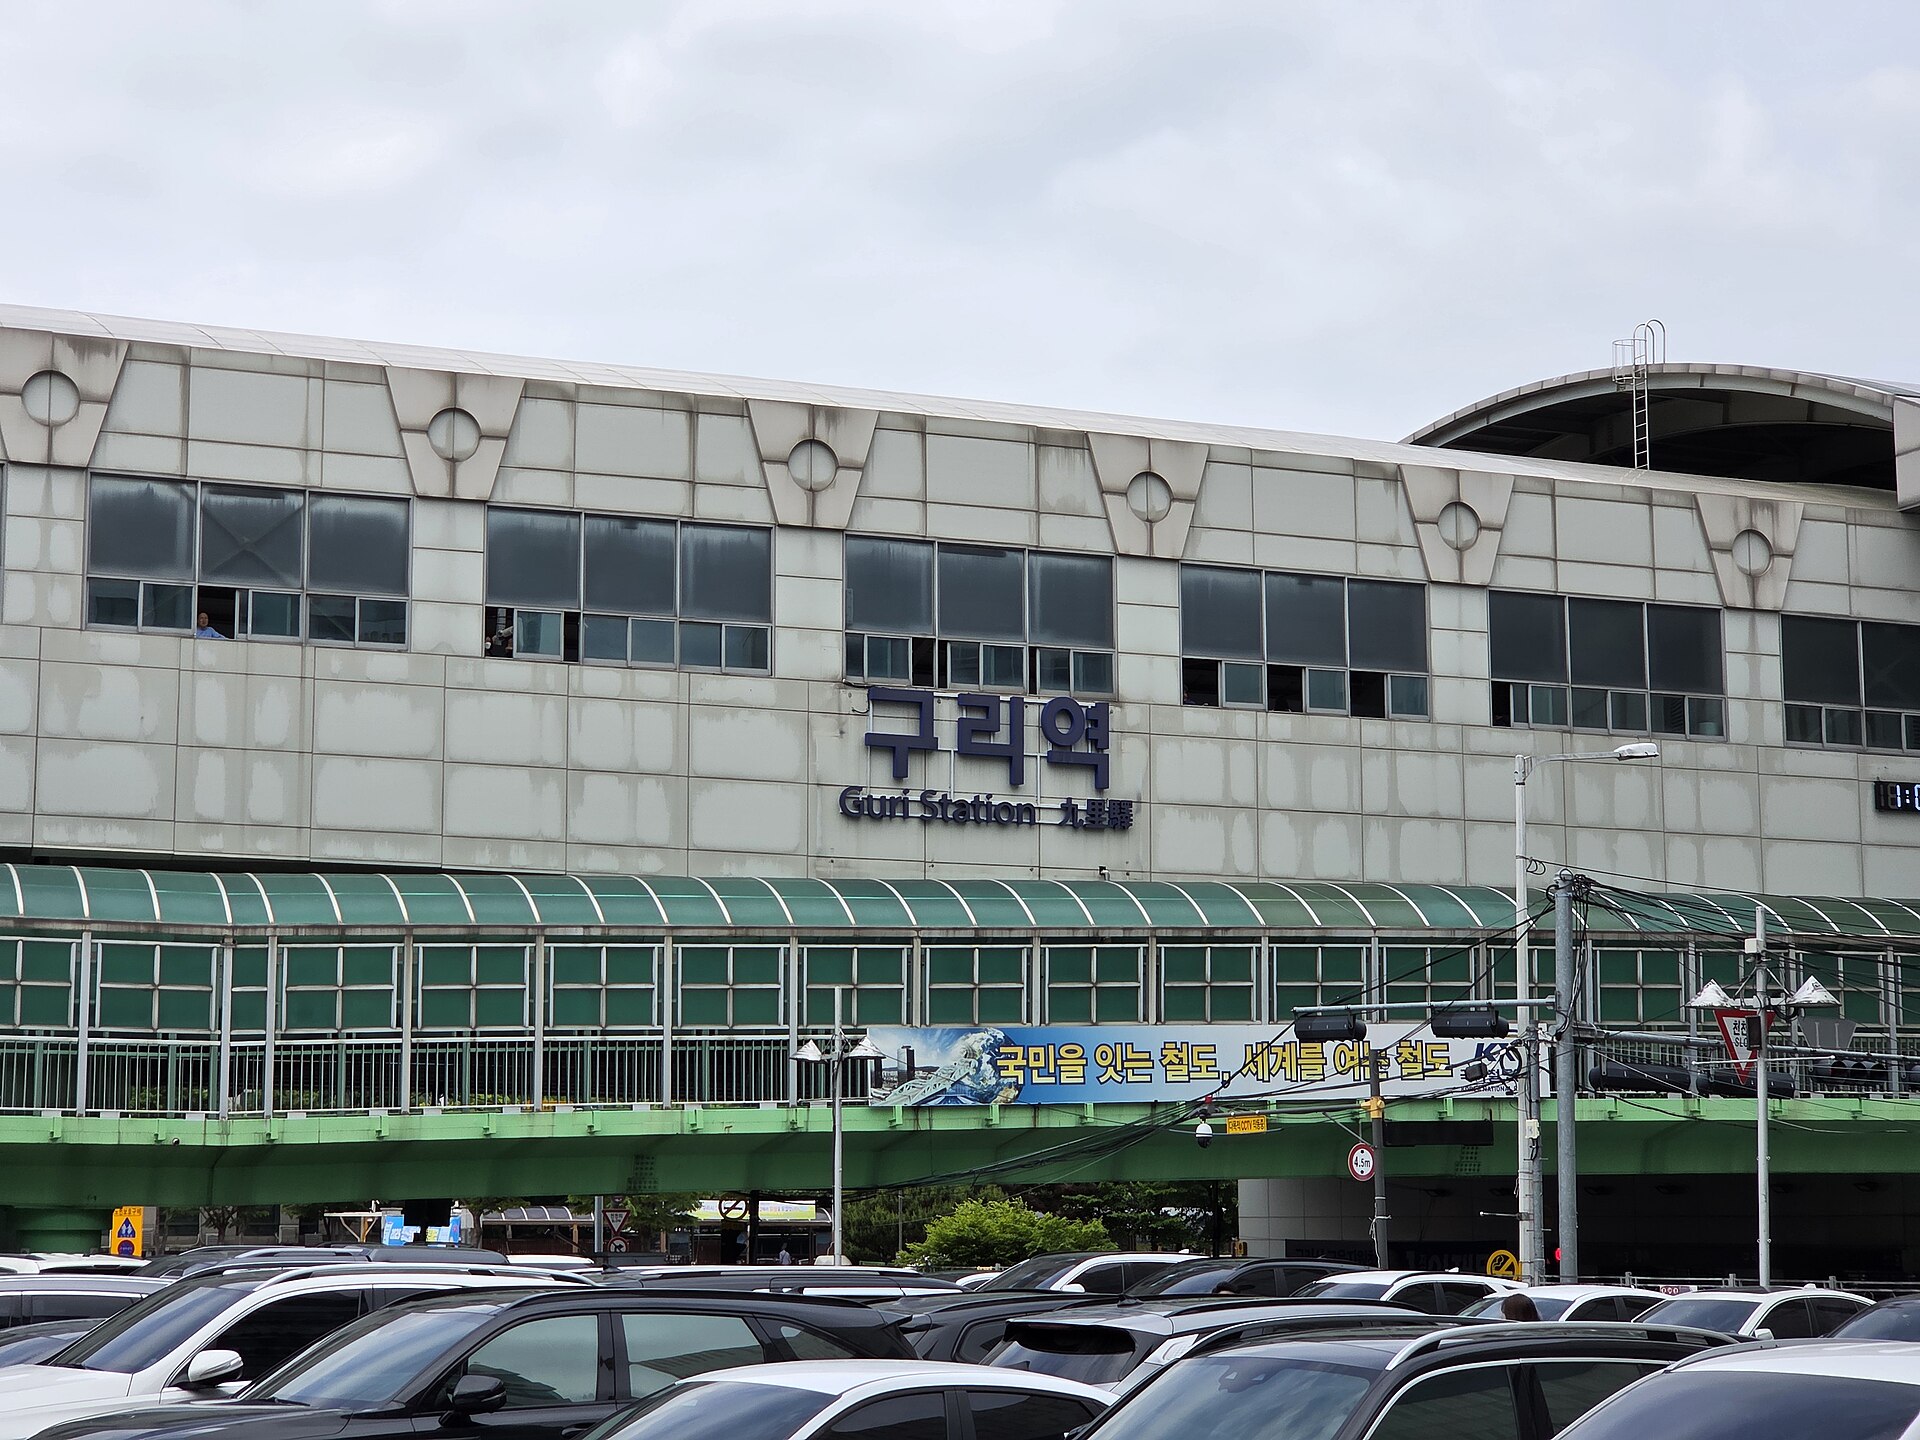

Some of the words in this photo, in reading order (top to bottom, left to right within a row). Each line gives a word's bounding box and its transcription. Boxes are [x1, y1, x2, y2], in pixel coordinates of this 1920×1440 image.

[865, 686, 1110, 790] 구리역
[838, 785, 910, 821] Guri
[919, 789, 1036, 827] Station
[996, 1042, 1087, 1085] 국민을
[1094, 1042, 1153, 1084] 잇는
[1160, 1041, 1231, 1089] 철도,
[1240, 1041, 1327, 1082] 세계를
[1396, 1040, 1453, 1081] 철도
[1354, 1156, 1371, 1168] 4.5m
